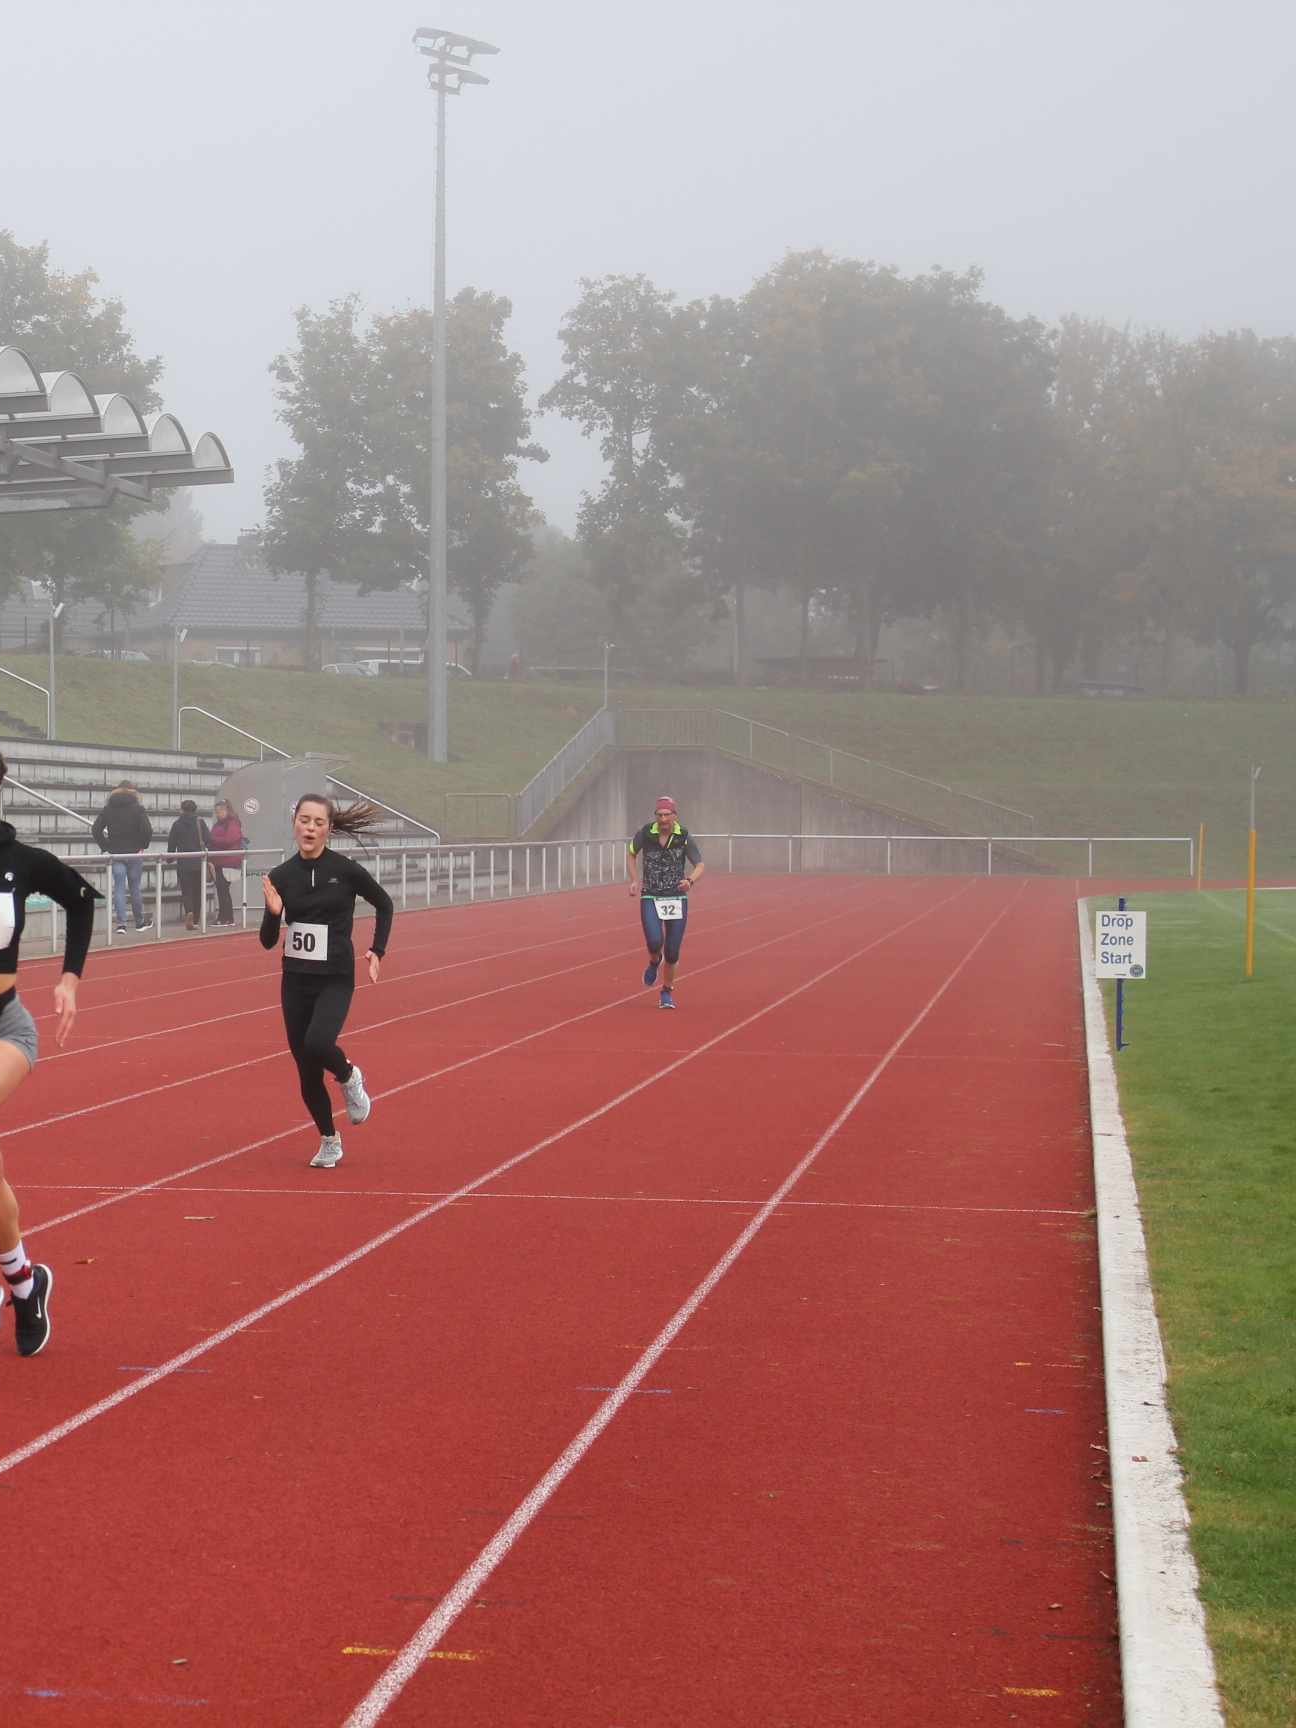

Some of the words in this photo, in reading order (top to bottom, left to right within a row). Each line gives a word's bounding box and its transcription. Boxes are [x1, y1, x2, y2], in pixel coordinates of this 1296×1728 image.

[661, 904, 675, 916] 32
[1101, 914, 1134, 930] Drop
[292, 932, 316, 952] 50
[1101, 933, 1134, 946] Zone
[1100, 951, 1132, 964] Start
